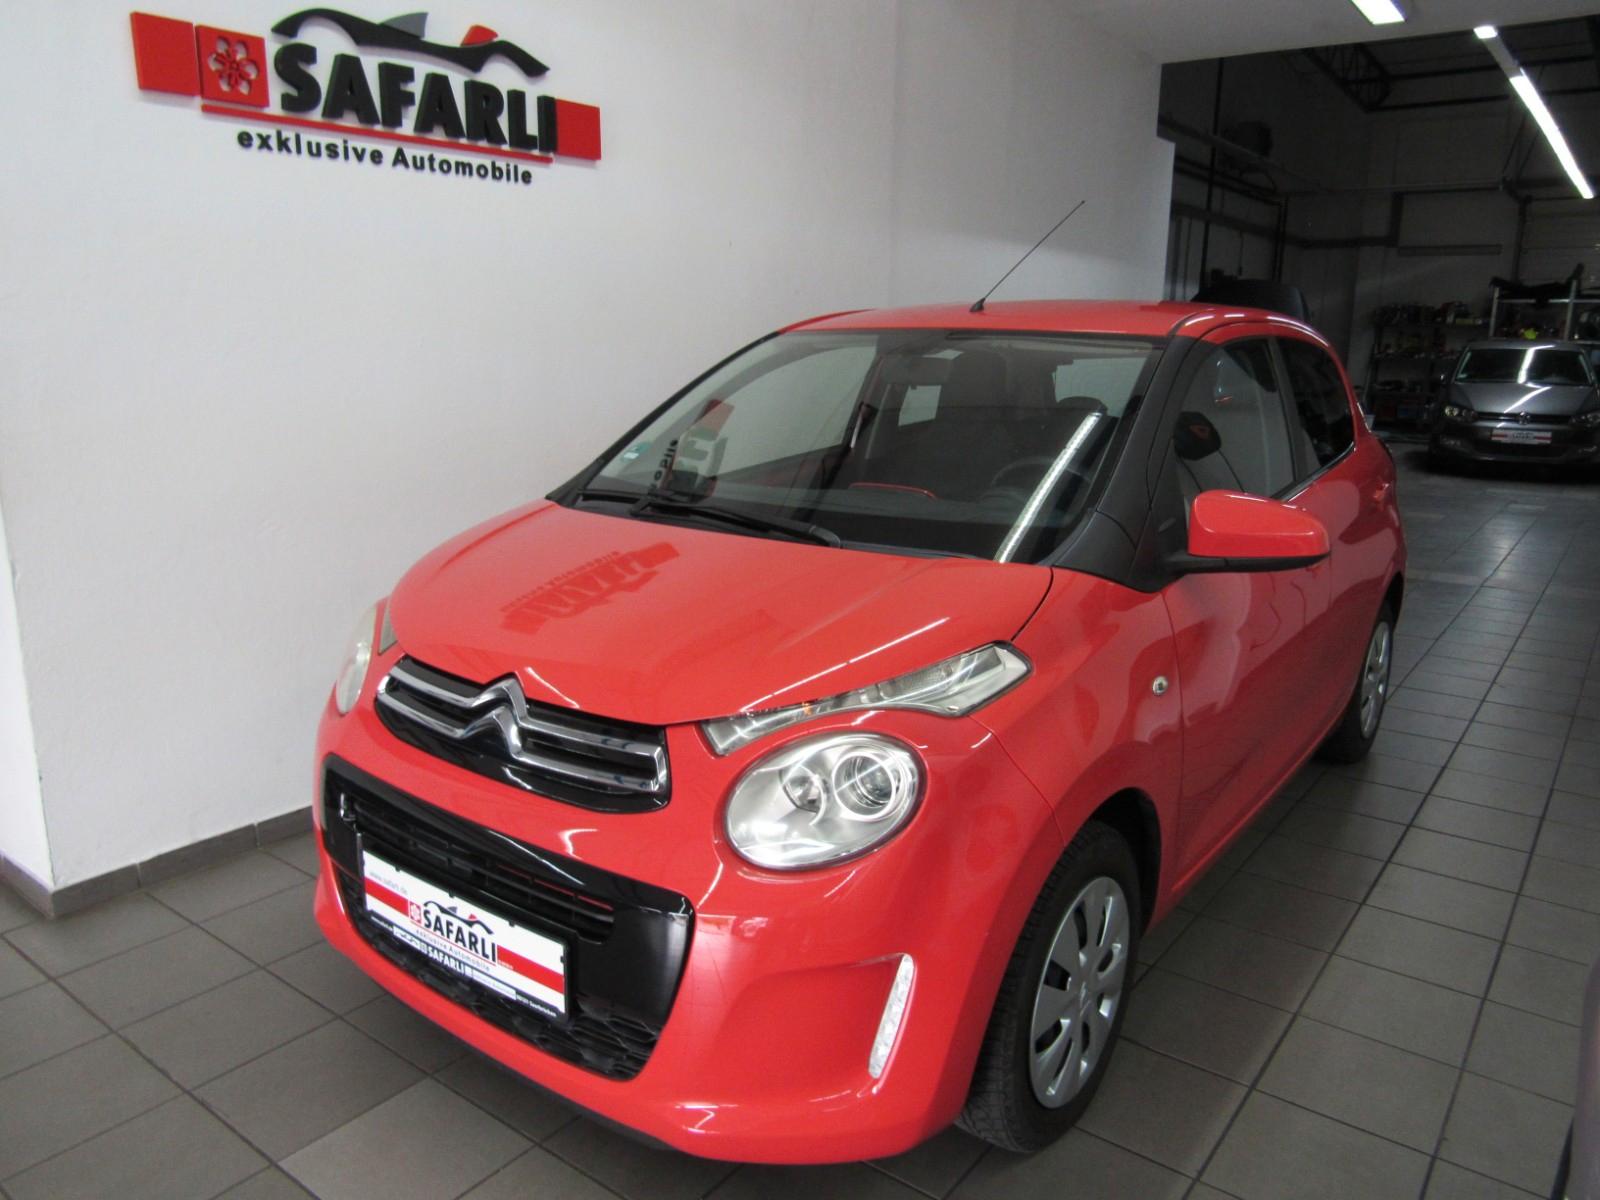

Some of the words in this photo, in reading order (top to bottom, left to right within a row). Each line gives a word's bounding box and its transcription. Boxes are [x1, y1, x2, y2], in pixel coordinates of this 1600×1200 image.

[273, 42, 557, 154] SAFARLI
[237, 129, 384, 166] exklusive
[391, 146, 533, 184] Automobile
[423, 909, 496, 963] SAFARLI
